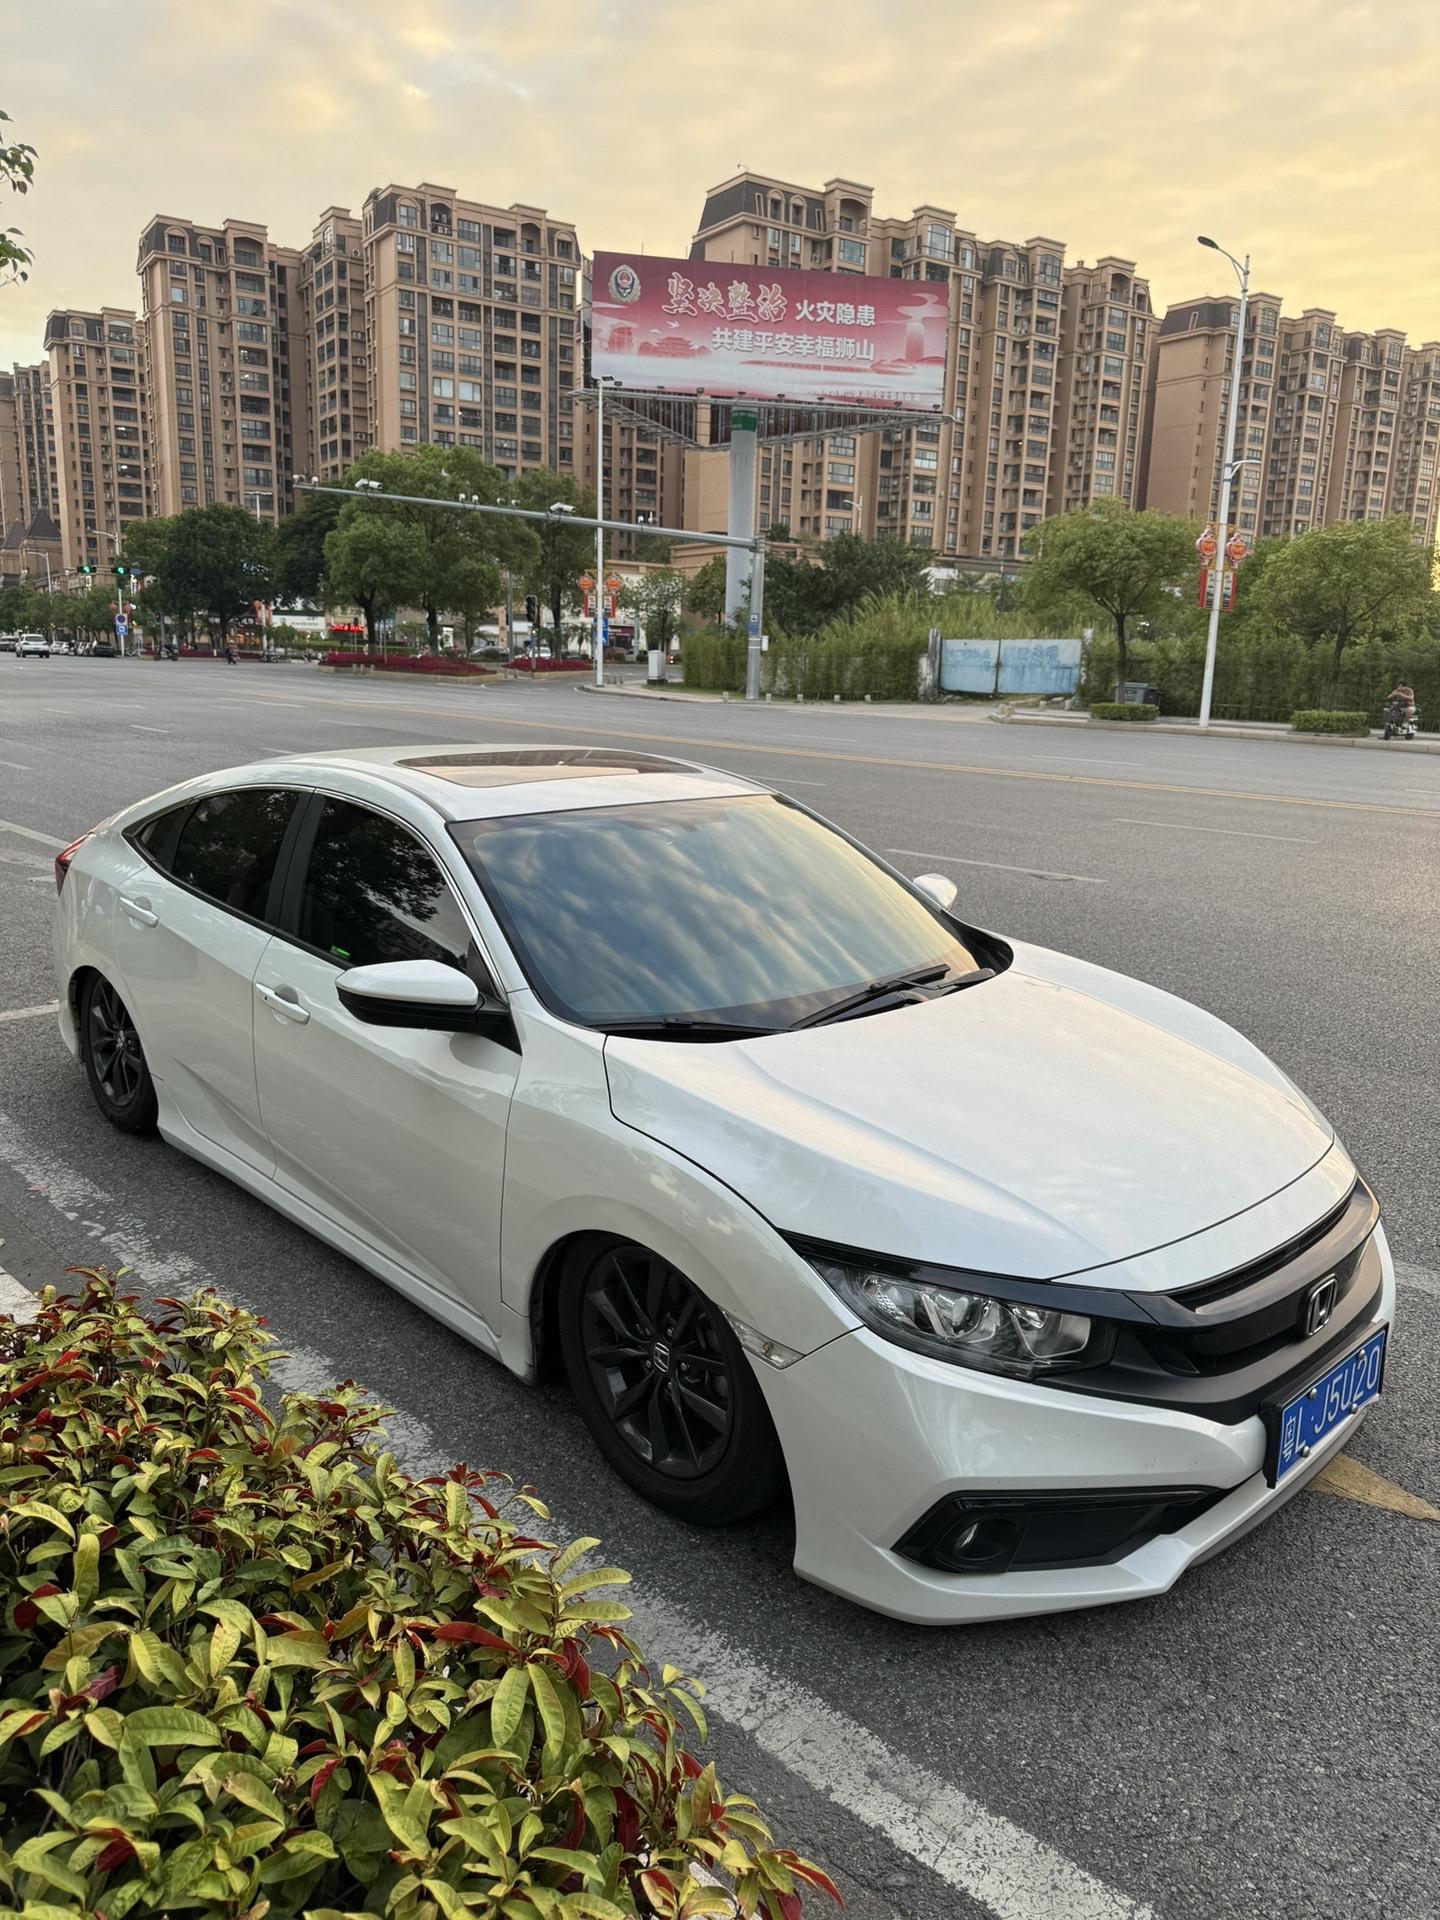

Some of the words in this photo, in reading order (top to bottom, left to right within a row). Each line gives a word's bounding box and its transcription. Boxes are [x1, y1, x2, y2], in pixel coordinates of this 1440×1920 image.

[662, 272, 788, 323] 坚决整治
[795, 299, 876, 326] 火灾隐患
[711, 326, 874, 361] 共建平安幸福狮山
